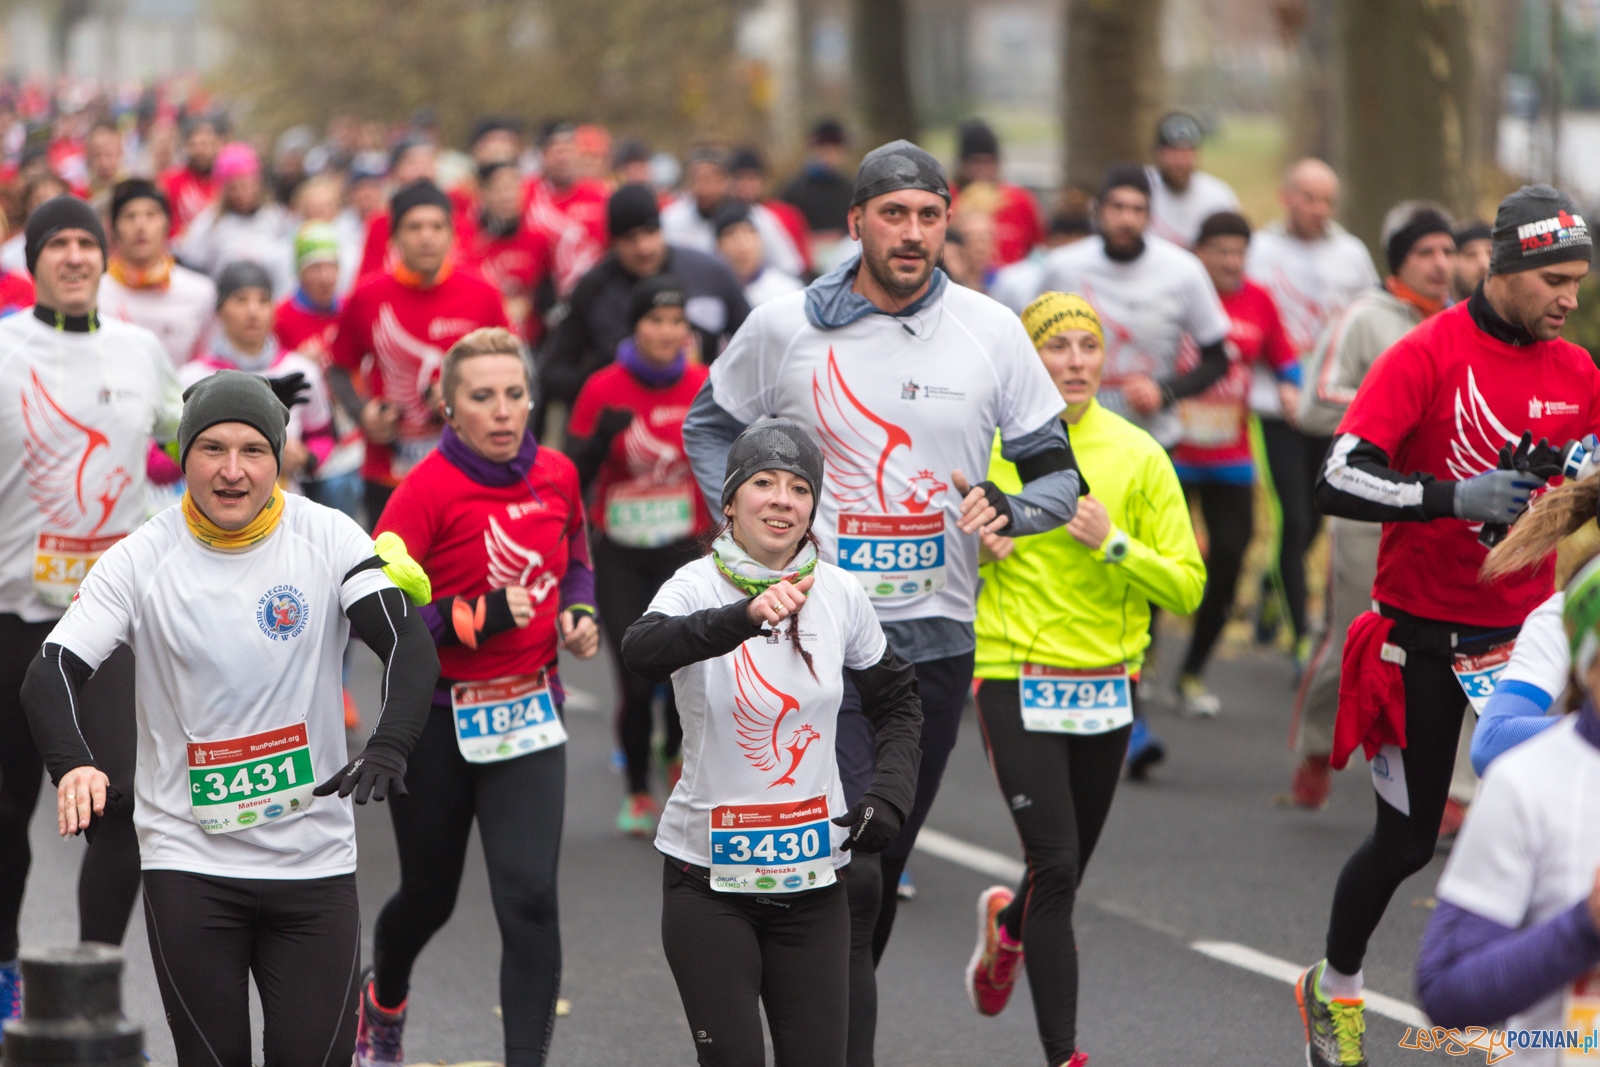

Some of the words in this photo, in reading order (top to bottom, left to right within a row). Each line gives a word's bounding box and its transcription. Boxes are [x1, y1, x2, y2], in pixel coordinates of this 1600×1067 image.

[1520, 232, 1553, 251] 70.3
[840, 549, 848, 560] E
[850, 541, 938, 570] 4589
[48, 557, 92, 582] 34
[258, 584, 304, 605] WIECZORNE
[256, 611, 278, 641] BIEGANIE
[292, 603, 309, 638] GRYFINIE
[1036, 682, 1118, 708] 3794
[472, 697, 545, 735] 1824
[209, 750, 216, 760] 1
[250, 734, 300, 752] RunPoland.org
[192, 783, 200, 793] C
[204, 756, 296, 801] 3431
[238, 798, 272, 810] Mateusz
[738, 813, 744, 823] 1
[780, 807, 822, 820] RunPoland.org
[714, 844, 723, 853] E
[728, 828, 820, 862] 3430
